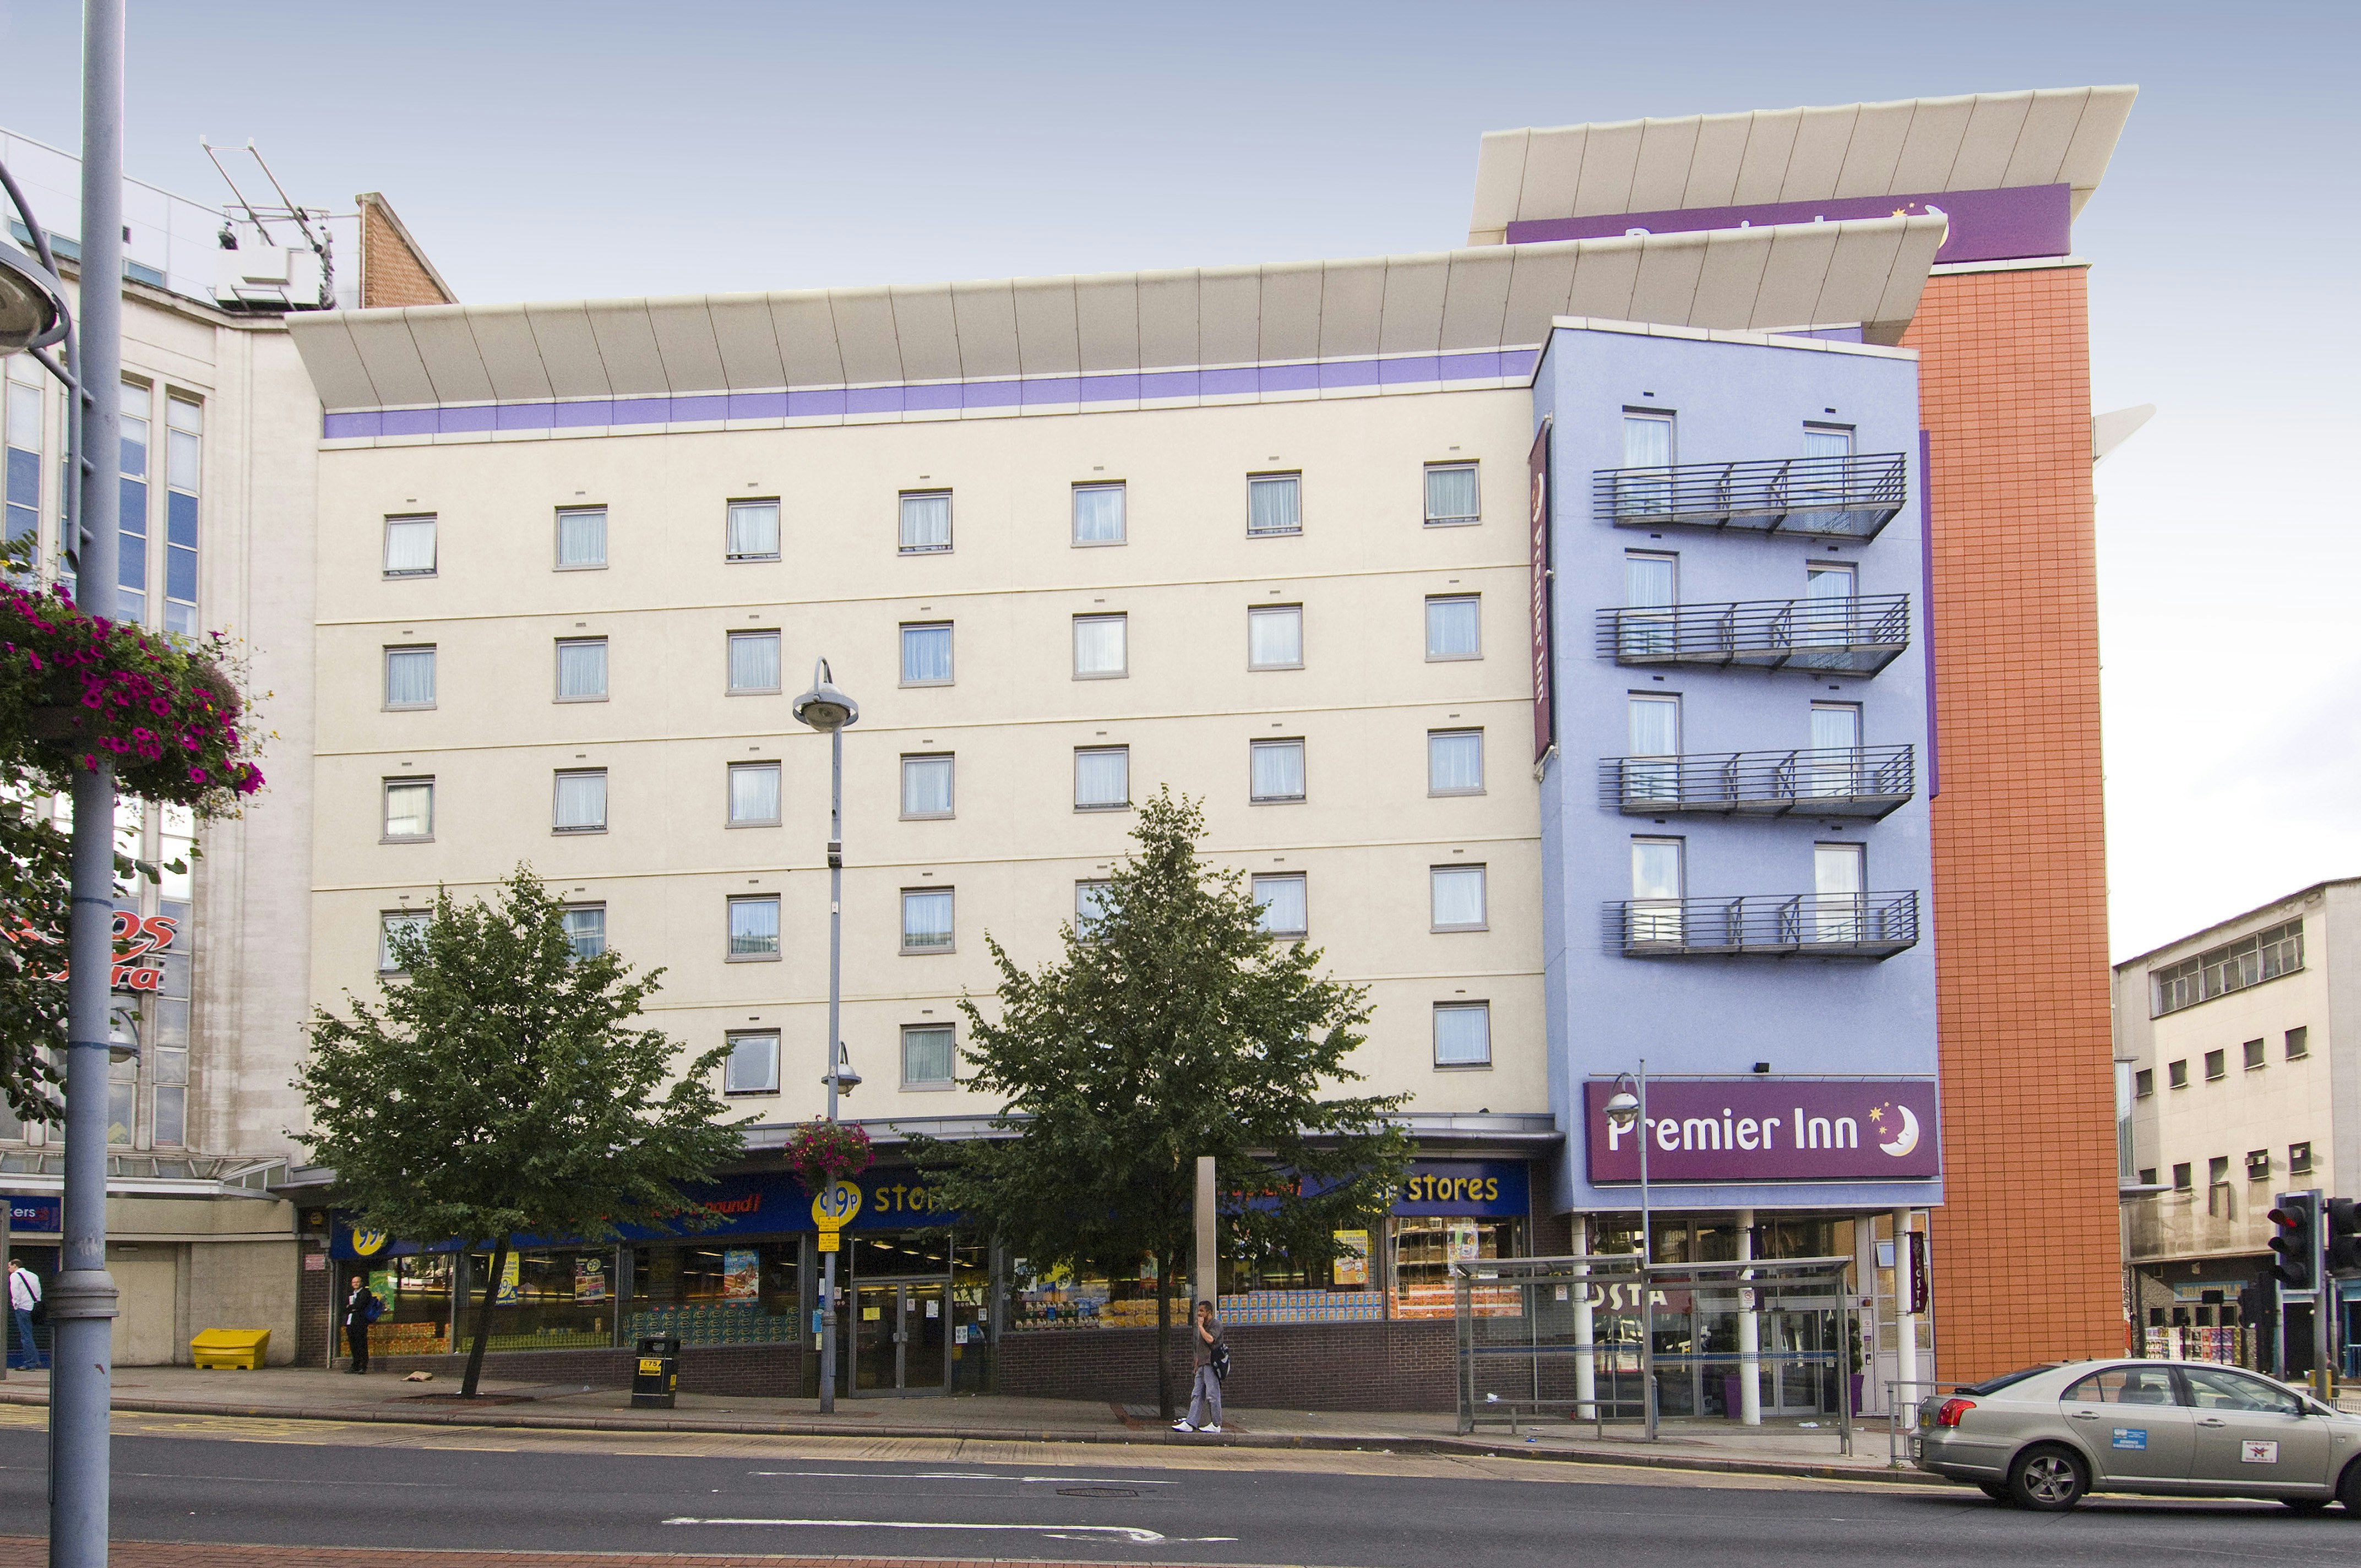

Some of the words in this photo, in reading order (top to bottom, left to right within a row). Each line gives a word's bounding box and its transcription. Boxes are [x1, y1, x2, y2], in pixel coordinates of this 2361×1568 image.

[1533, 525, 1543, 647] Premier
[1609, 1108, 1780, 1151] Premier
[1794, 1107, 1858, 1149] Inn
[874, 1183, 944, 1212] stor
[1408, 1173, 1498, 1201] stores
[1591, 1283, 1668, 1311] OSTA
